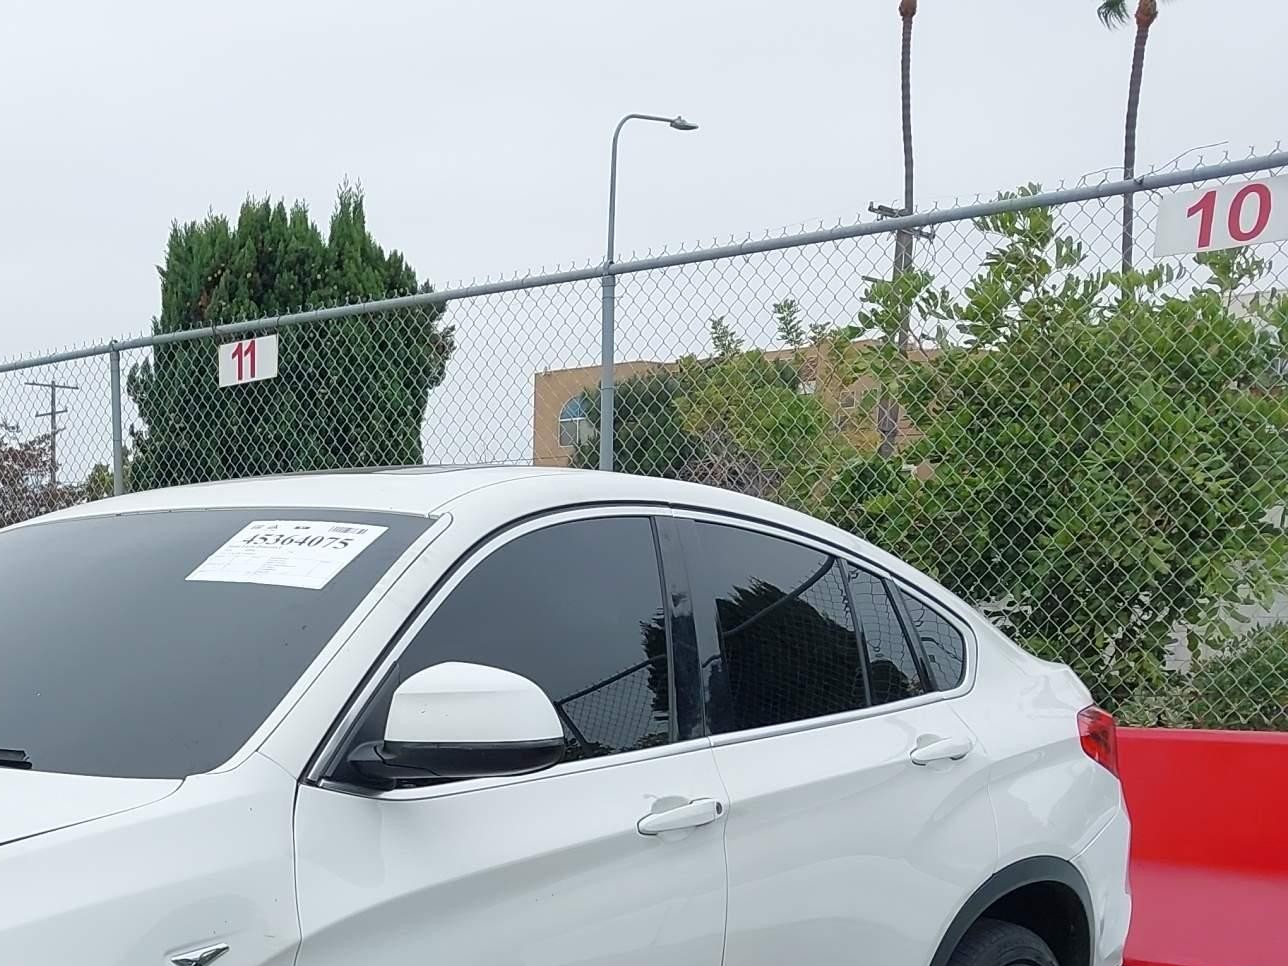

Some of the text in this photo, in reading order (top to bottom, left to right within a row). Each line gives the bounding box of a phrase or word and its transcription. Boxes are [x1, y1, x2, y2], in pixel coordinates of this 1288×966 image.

[1186, 183, 1272, 249] 10
[231, 339, 256, 381] 11
[242, 533, 354, 550] 45364075
